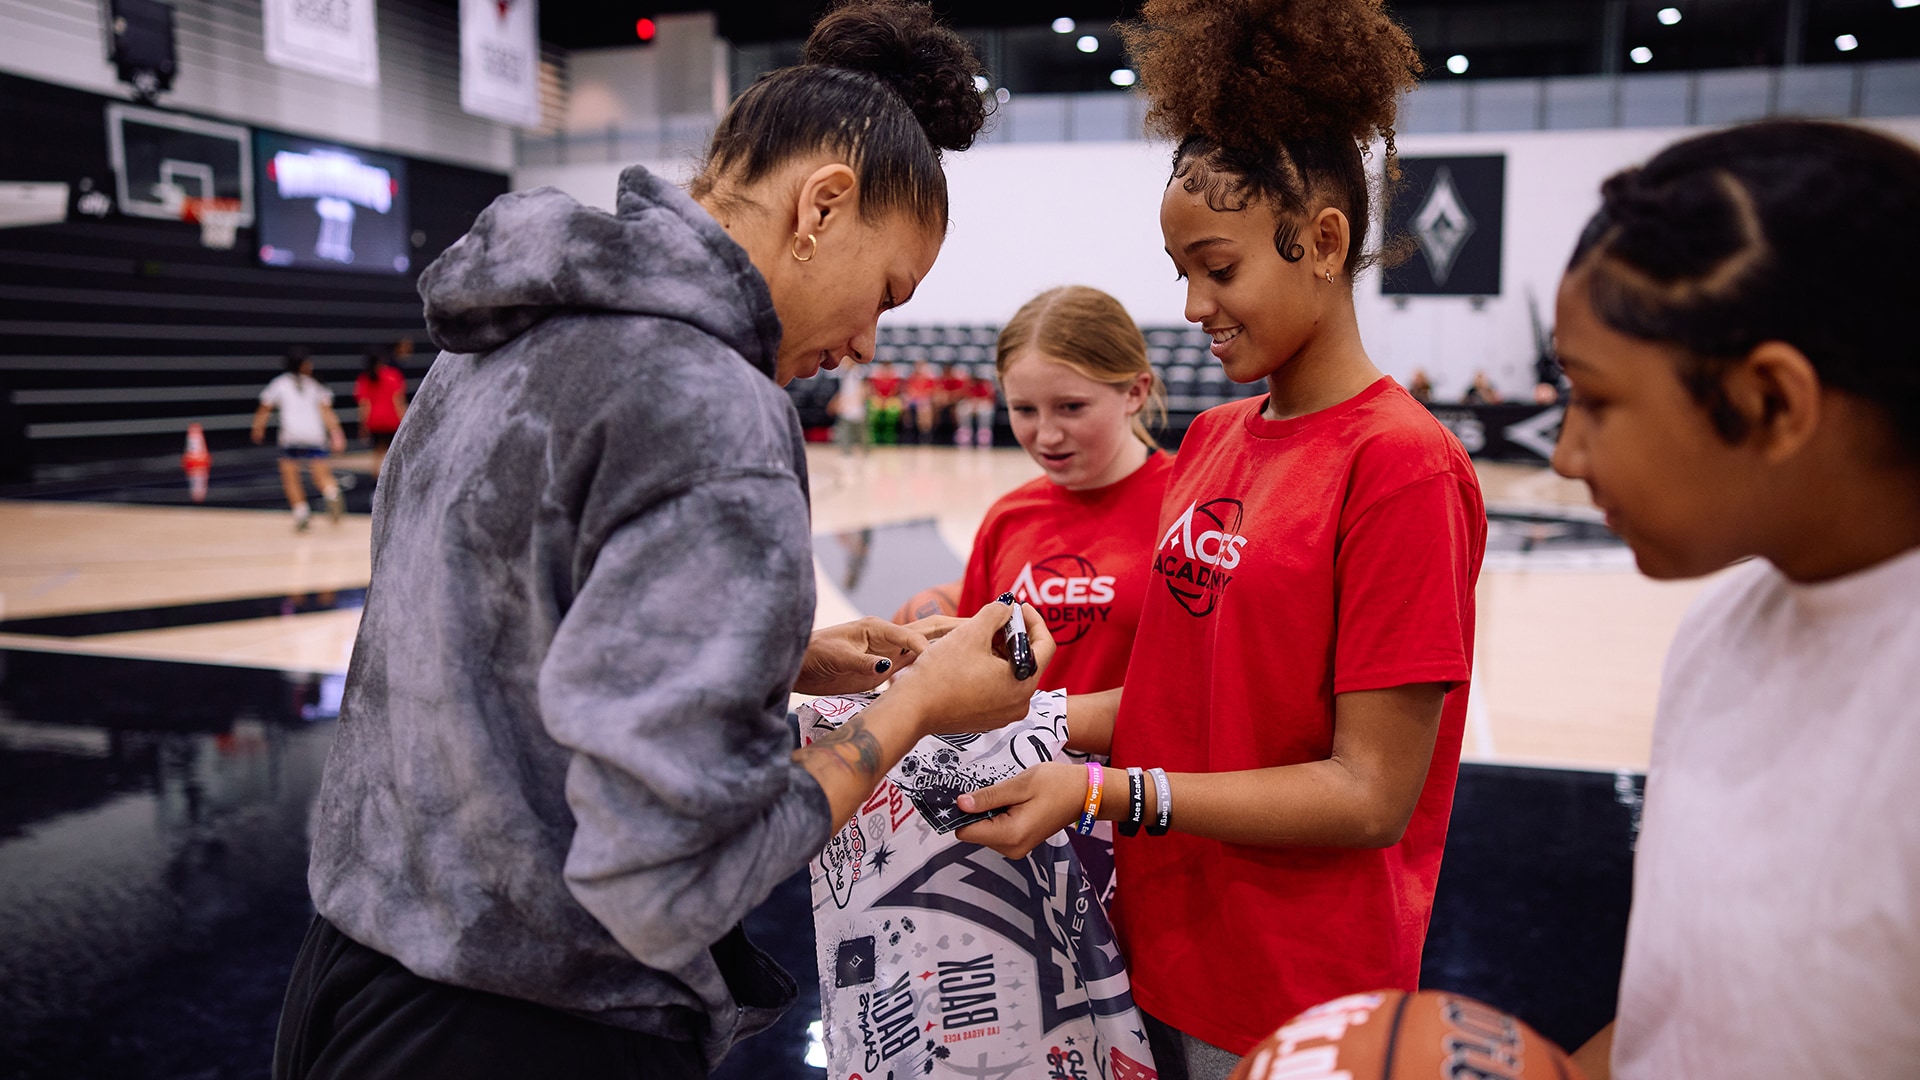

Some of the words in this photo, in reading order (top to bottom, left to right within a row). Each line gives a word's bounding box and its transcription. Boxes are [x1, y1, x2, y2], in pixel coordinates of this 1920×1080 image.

[1158, 499, 1248, 570] ACES
[1010, 561, 1116, 605] ACES
[1152, 554, 1233, 594] ACADMY
[1132, 802, 1142, 822] Aces
[1159, 801, 1170, 827] Energy
